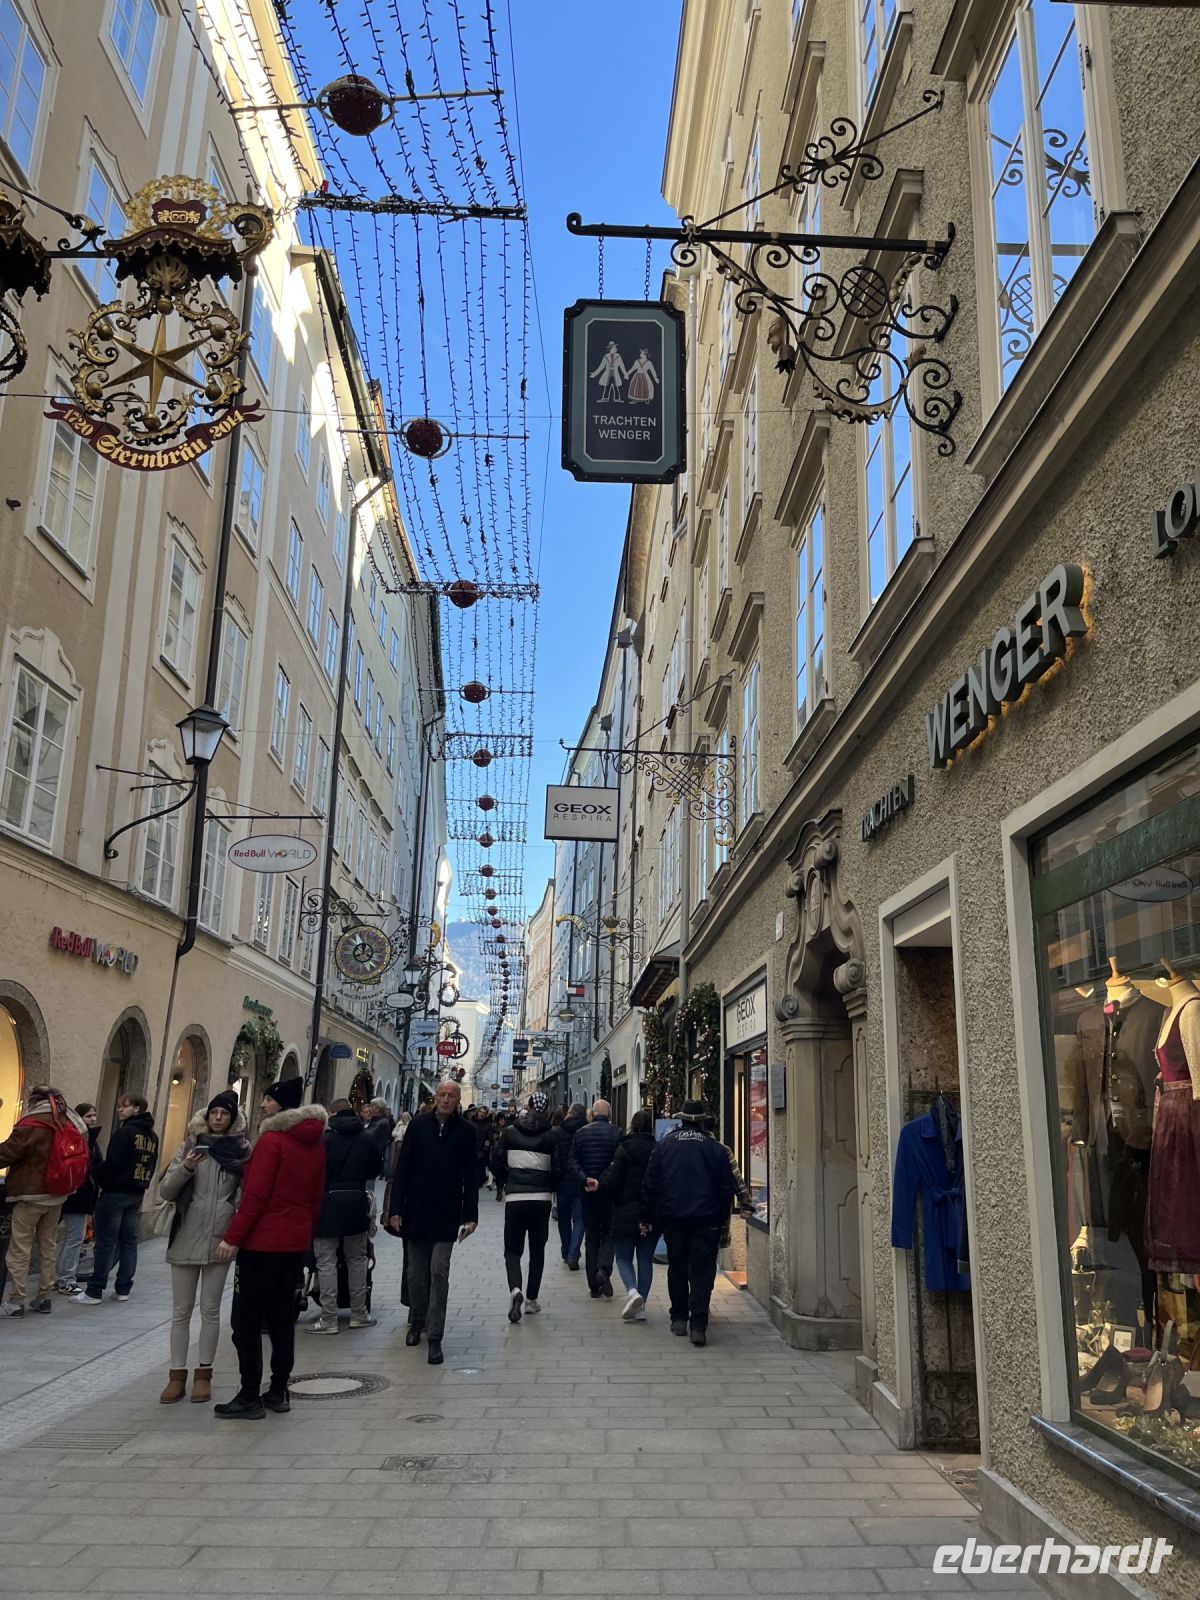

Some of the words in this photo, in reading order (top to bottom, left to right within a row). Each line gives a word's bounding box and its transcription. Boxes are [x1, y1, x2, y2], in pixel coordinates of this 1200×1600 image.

[63, 408, 94, 437] 1720
[209, 410, 246, 440] 2014
[593, 415, 657, 427] TRACHTEN
[599, 429, 651, 441] WENGER
[96, 434, 208, 469] Sternbräu
[926, 563, 1087, 768] WENGER
[553, 802, 613, 815] GEOX
[553, 813, 613, 823] RESPIRA
[233, 849, 250, 858] Red
[250, 849, 266, 858] Bull
[51, 926, 74, 952] Red
[74, 933, 96, 959] Bull
[336, 988, 385, 1001] Aschauer
[736, 993, 756, 1023] GEOX
